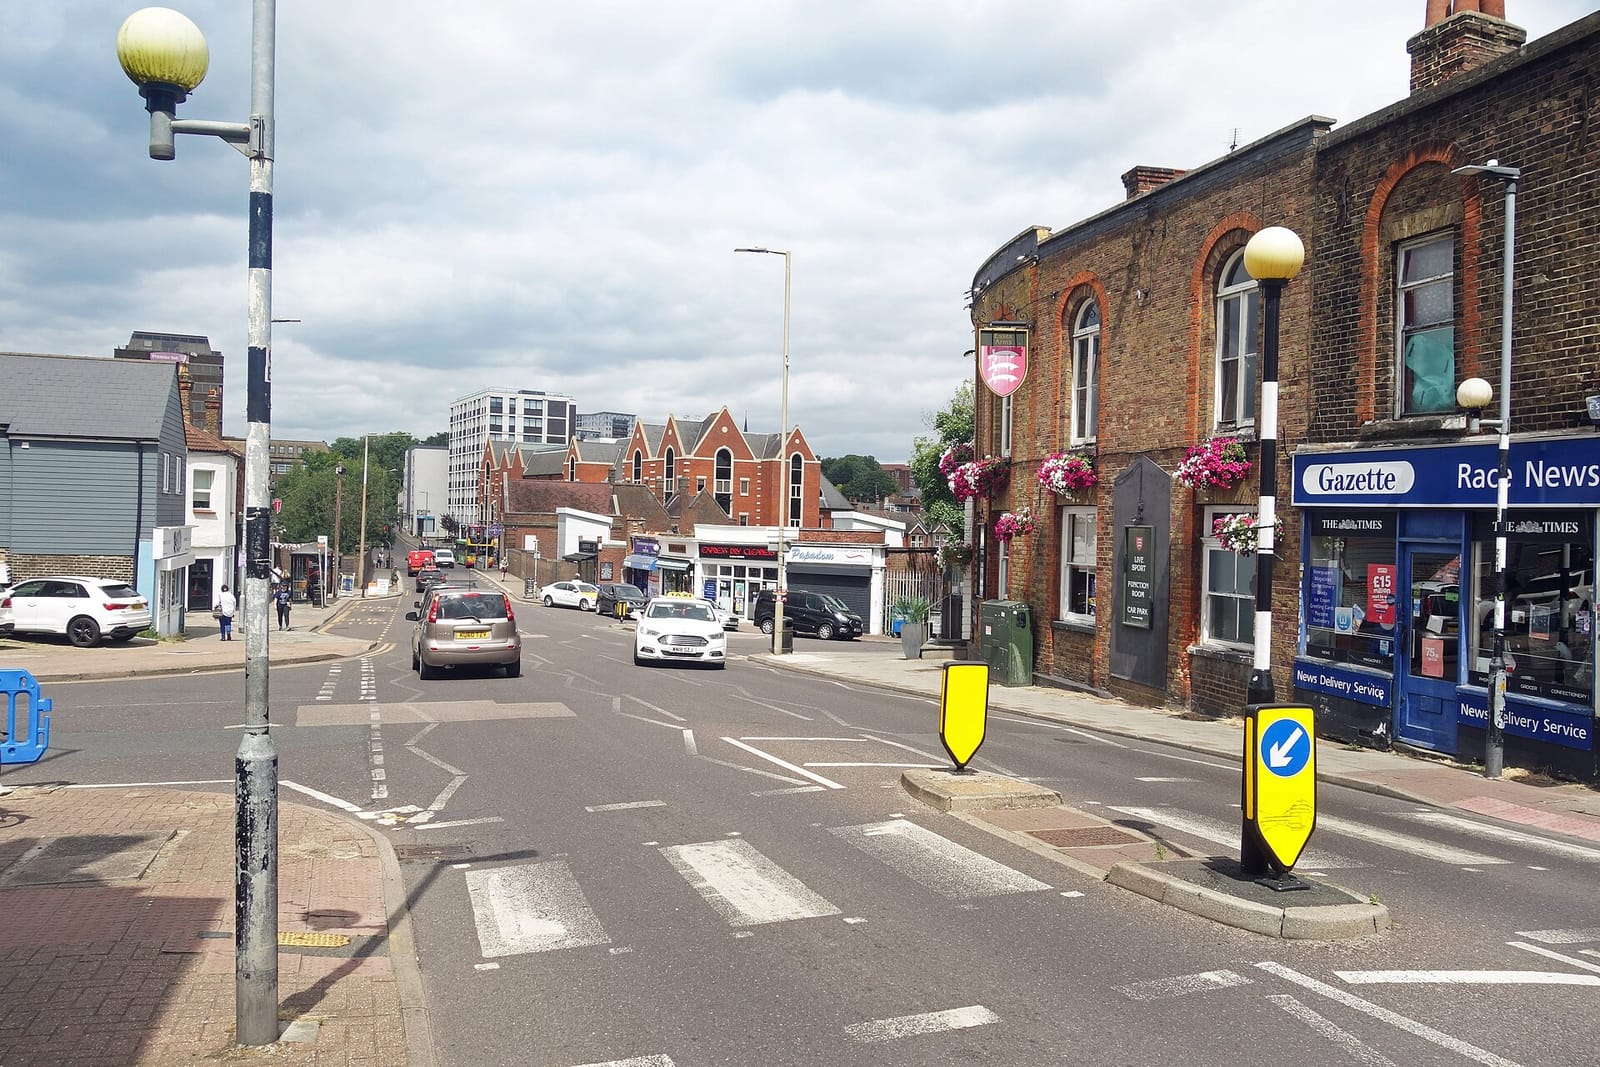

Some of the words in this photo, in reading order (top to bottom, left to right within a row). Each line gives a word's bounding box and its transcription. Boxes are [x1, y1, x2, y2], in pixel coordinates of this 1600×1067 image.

[1318, 465, 1396, 492] Gazette
[1525, 460, 1600, 488] News
[1322, 519, 1338, 529] THE
[1356, 519, 1383, 530] TIMES
[1542, 521, 1579, 533] TIMES
[791, 548, 834, 561] Papadom
[1133, 556, 1144, 564] LIVE
[1131, 564, 1146, 572] SPORT
[1127, 580, 1149, 589] FUNCTION
[1373, 576, 1391, 588] £15
[1131, 590, 1145, 598] ROOM
[1127, 606, 1136, 614] CAR
[1136, 607, 1149, 616] PARK
[1297, 670, 1318, 684] News
[1320, 675, 1352, 694] Delivery
[1353, 682, 1385, 699] Service
[1550, 688, 1588, 700] CONFECTIONERY
[1460, 703, 1489, 720] News
[1503, 711, 1539, 732] elivery
[1543, 719, 1587, 740] Service
